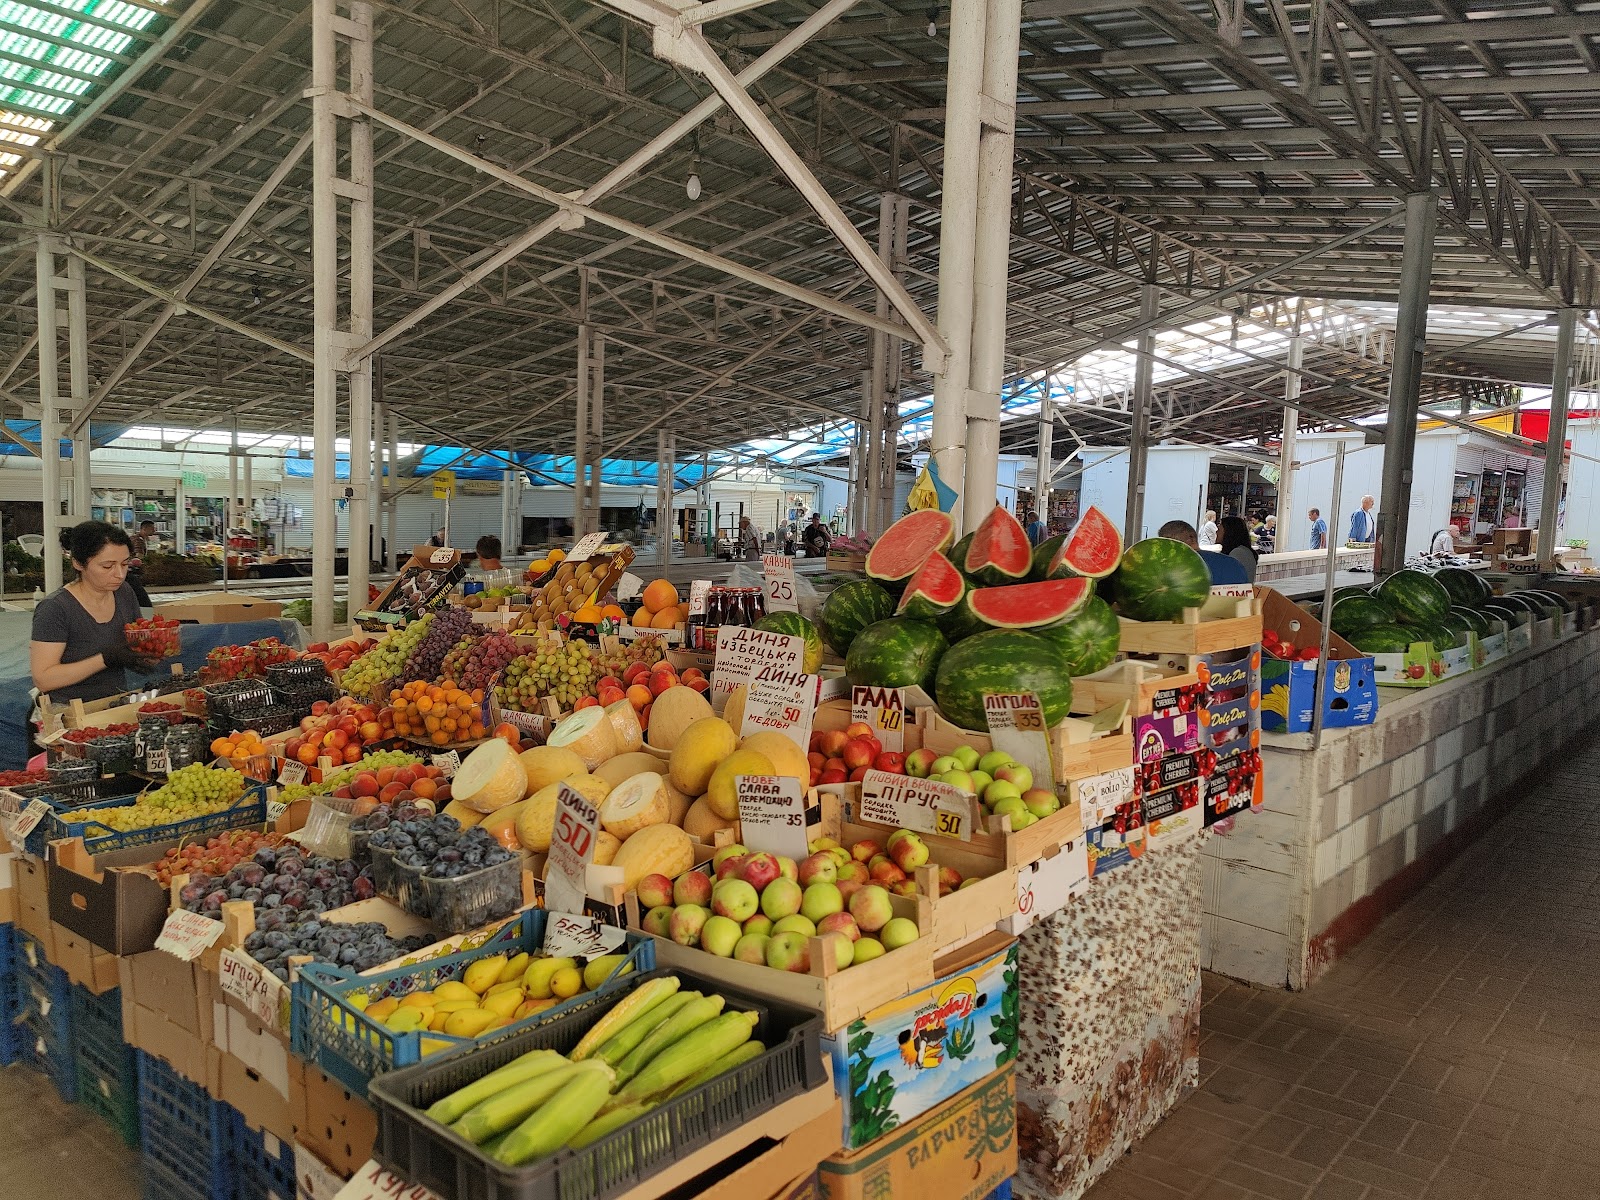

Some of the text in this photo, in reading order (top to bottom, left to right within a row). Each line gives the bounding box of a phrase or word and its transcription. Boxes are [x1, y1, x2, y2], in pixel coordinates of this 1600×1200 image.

[427, 582, 453, 608] TERRAVITA
[770, 580, 793, 600] 25
[732, 629, 791, 648] ДИНЯ
[755, 666, 809, 688] ДИНЯ
[853, 686, 903, 711] ГАЛА
[986, 693, 1039, 710] ЛІГОЛЬ
[782, 706, 801, 722] 50
[880, 709, 901, 730] 40
[1019, 712, 1041, 728] 35
[150, 759, 166, 770] 50
[1165, 758, 1190, 772] PREMIUM
[1164, 767, 1190, 781] CHERRIES
[738, 783, 780, 795] СЛАВА
[881, 785, 941, 811] ПІРУС
[1100, 783, 1120, 797] BOLLO
[557, 788, 598, 825] ДИНЯ
[1148, 793, 1173, 808] PREMIUM
[1147, 802, 1174, 818] CHERRIES
[786, 813, 803, 827] 35
[938, 813, 962, 835] 30
[556, 812, 592, 858] 50
[913, 993, 972, 1038] Tropical
